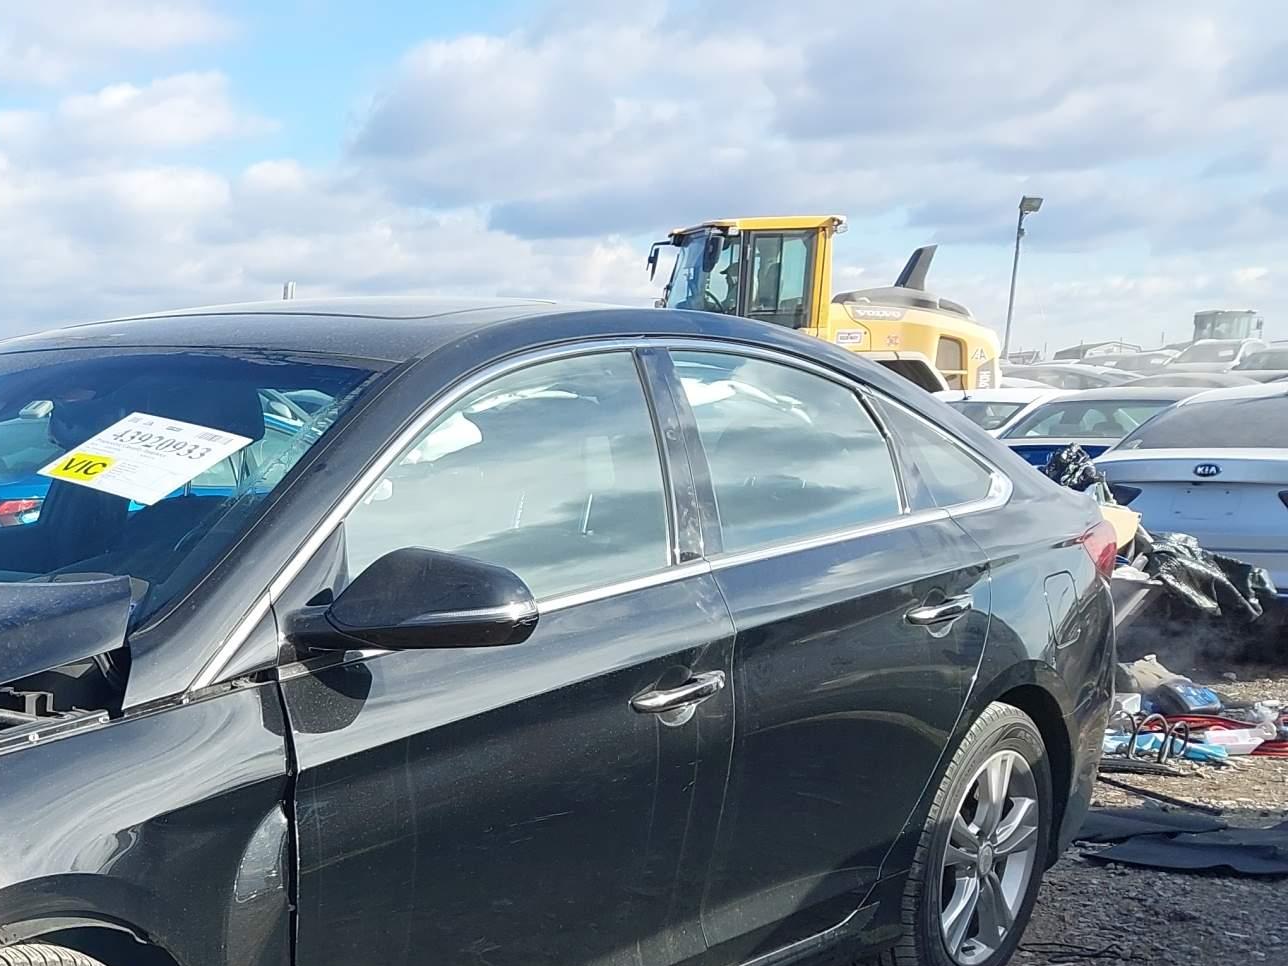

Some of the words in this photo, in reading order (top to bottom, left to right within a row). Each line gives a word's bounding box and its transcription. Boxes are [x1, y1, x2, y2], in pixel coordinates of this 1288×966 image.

[857, 310, 902, 318] VOLVO
[112, 429, 212, 460] 43920933
[62, 457, 108, 476] VIC
[1196, 465, 1218, 475] KIA
